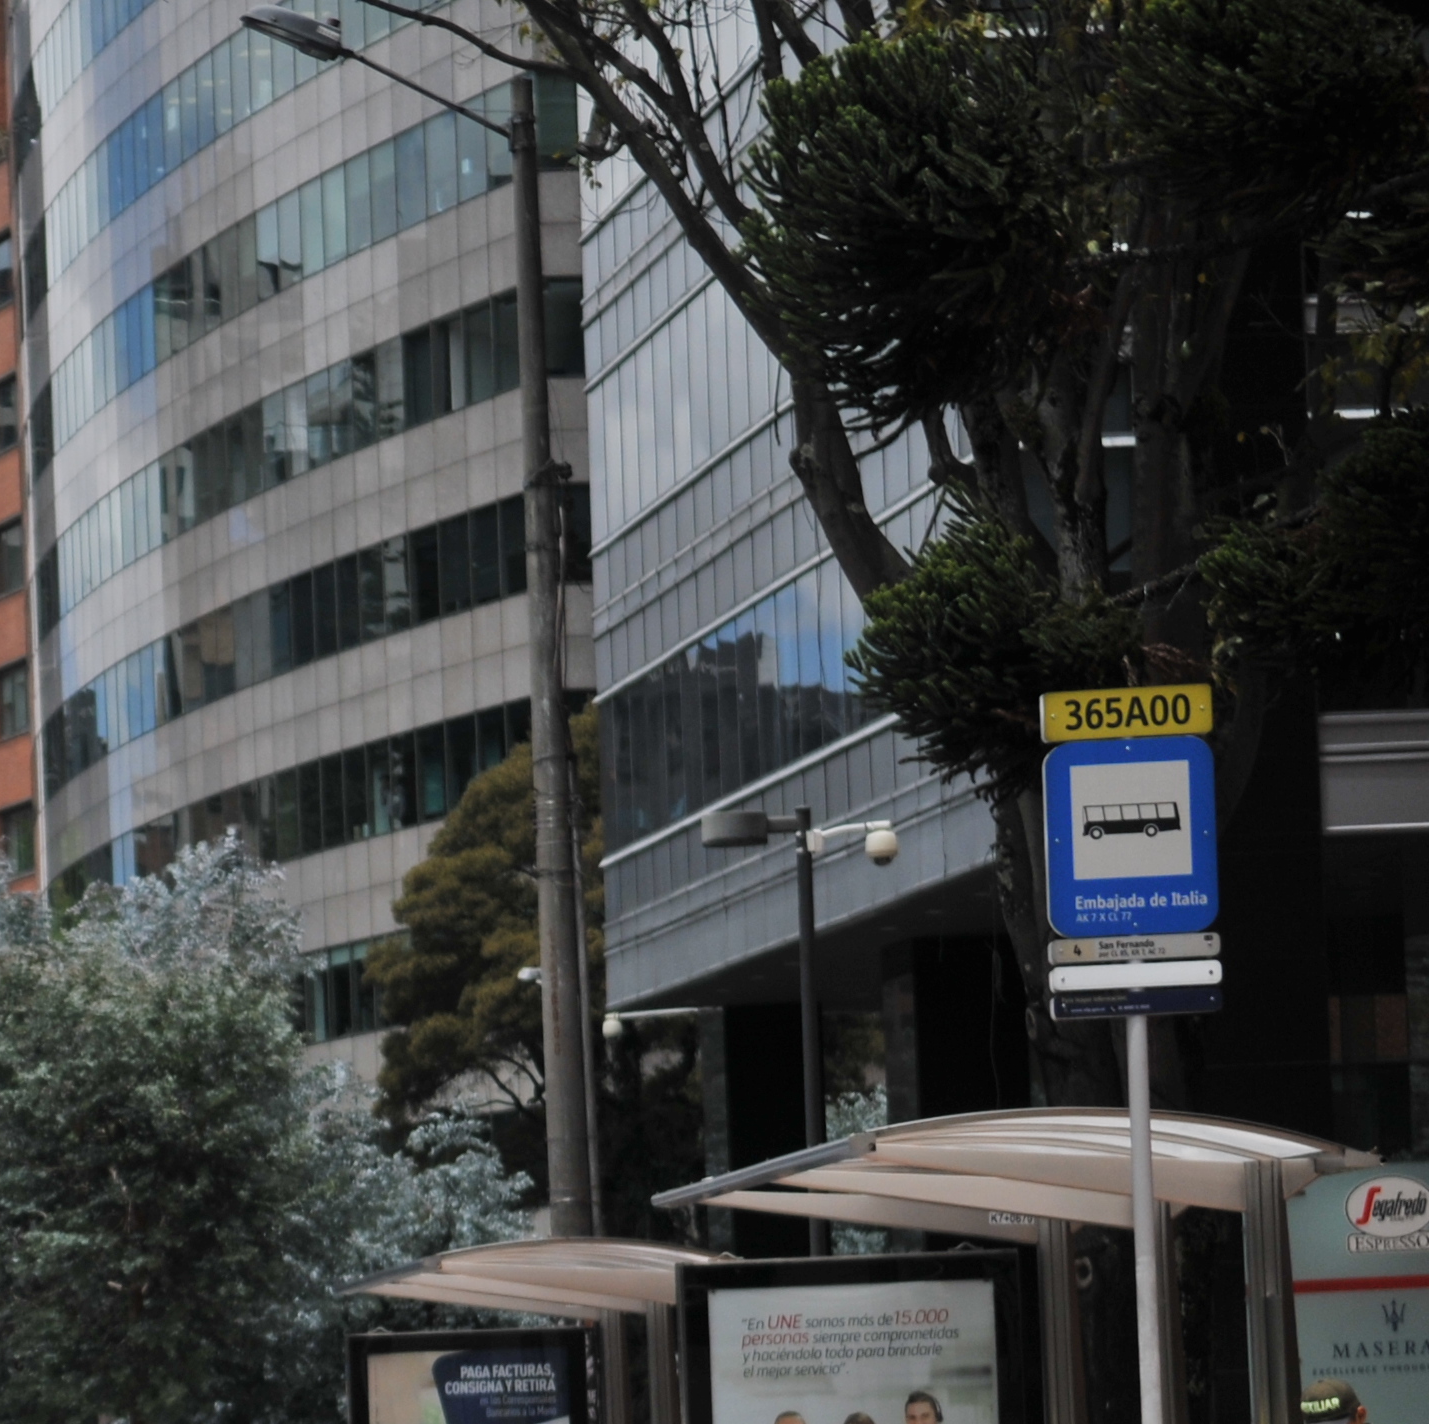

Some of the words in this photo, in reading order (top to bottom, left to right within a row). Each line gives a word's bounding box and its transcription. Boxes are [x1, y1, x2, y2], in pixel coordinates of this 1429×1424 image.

[1064, 693, 1191, 731] 365A00
[1074, 892, 1145, 912] Embajada
[1149, 893, 1167, 908] de
[1170, 890, 1209, 906] Italia
[1076, 912, 1089, 922] AK
[1092, 912, 1097, 922] 7
[1099, 912, 1106, 922] X
[1107, 911, 1118, 922] CL
[1121, 911, 1132, 921] 77
[1073, 944, 1082, 957] 4
[1098, 941, 1114, 950] San
[1116, 938, 1154, 949] Fernando
[1355, 1185, 1427, 1225] Segafredo
[1355, 1233, 1429, 1251] ESPRESSO
[767, 1313, 803, 1330] UNE
[805, 1316, 845, 1328] somos
[847, 1313, 874, 1327] más
[876, 1312, 893, 1326] de
[894, 1308, 949, 1326] 15.000
[742, 1330, 809, 1348] personas
[813, 1328, 861, 1344] siempre
[863, 1326, 960, 1344] comprometidas
[742, 1350, 752, 1365] y
[752, 1346, 822, 1362] haciéndolo
[824, 1344, 854, 1359] todo
[855, 1347, 886, 1361] para
[887, 1342, 943, 1358] brindarle
[460, 1364, 491, 1379] PAGA
[492, 1363, 556, 1379] FACTURAS,
[742, 1364, 754, 1378] el
[756, 1364, 793, 1380] mejor
[444, 1380, 504, 1395] CONSIGNA
[503, 1379, 512, 1393] Y
